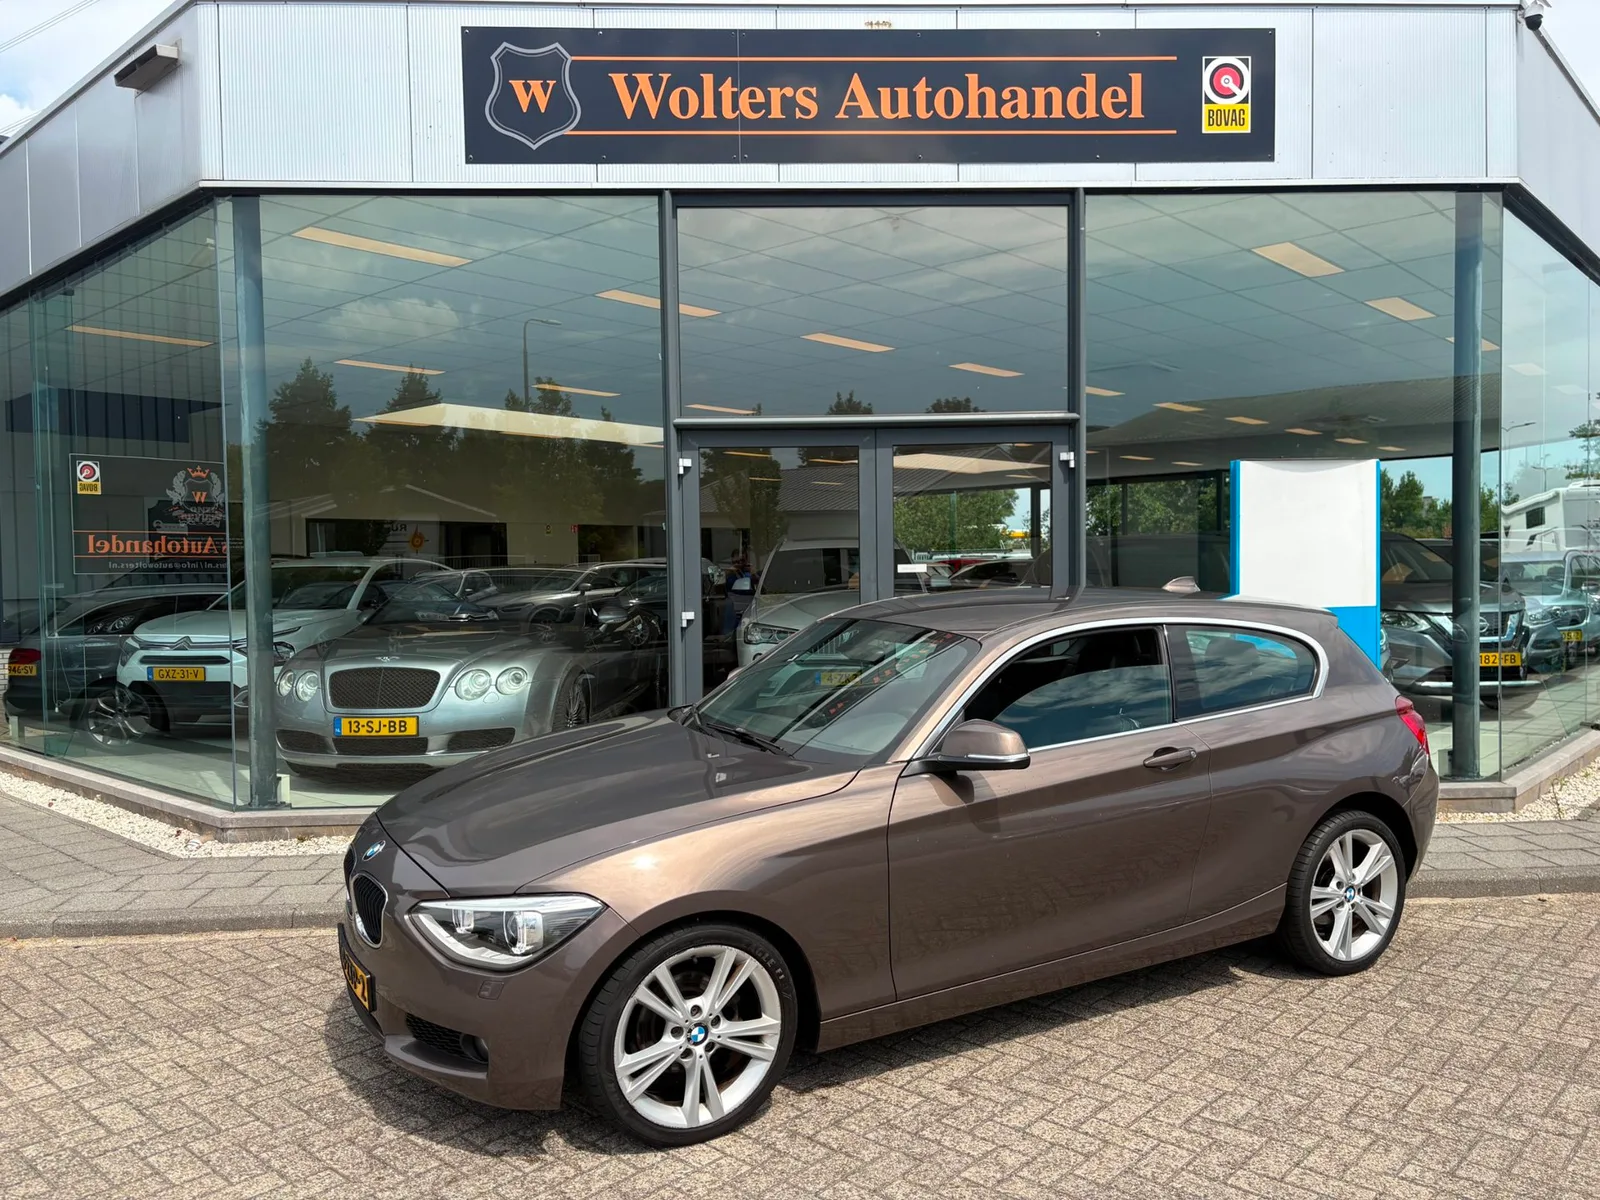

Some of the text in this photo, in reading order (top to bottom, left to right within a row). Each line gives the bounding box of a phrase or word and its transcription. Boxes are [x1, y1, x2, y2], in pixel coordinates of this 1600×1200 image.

[509, 80, 556, 113] W
[608, 72, 1144, 120] Wolters Autohandel
[1208, 108, 1245, 127] BOVAG
[158, 669, 199, 679] GXZ-31-V
[348, 720, 407, 733] 13-SJ-BB
